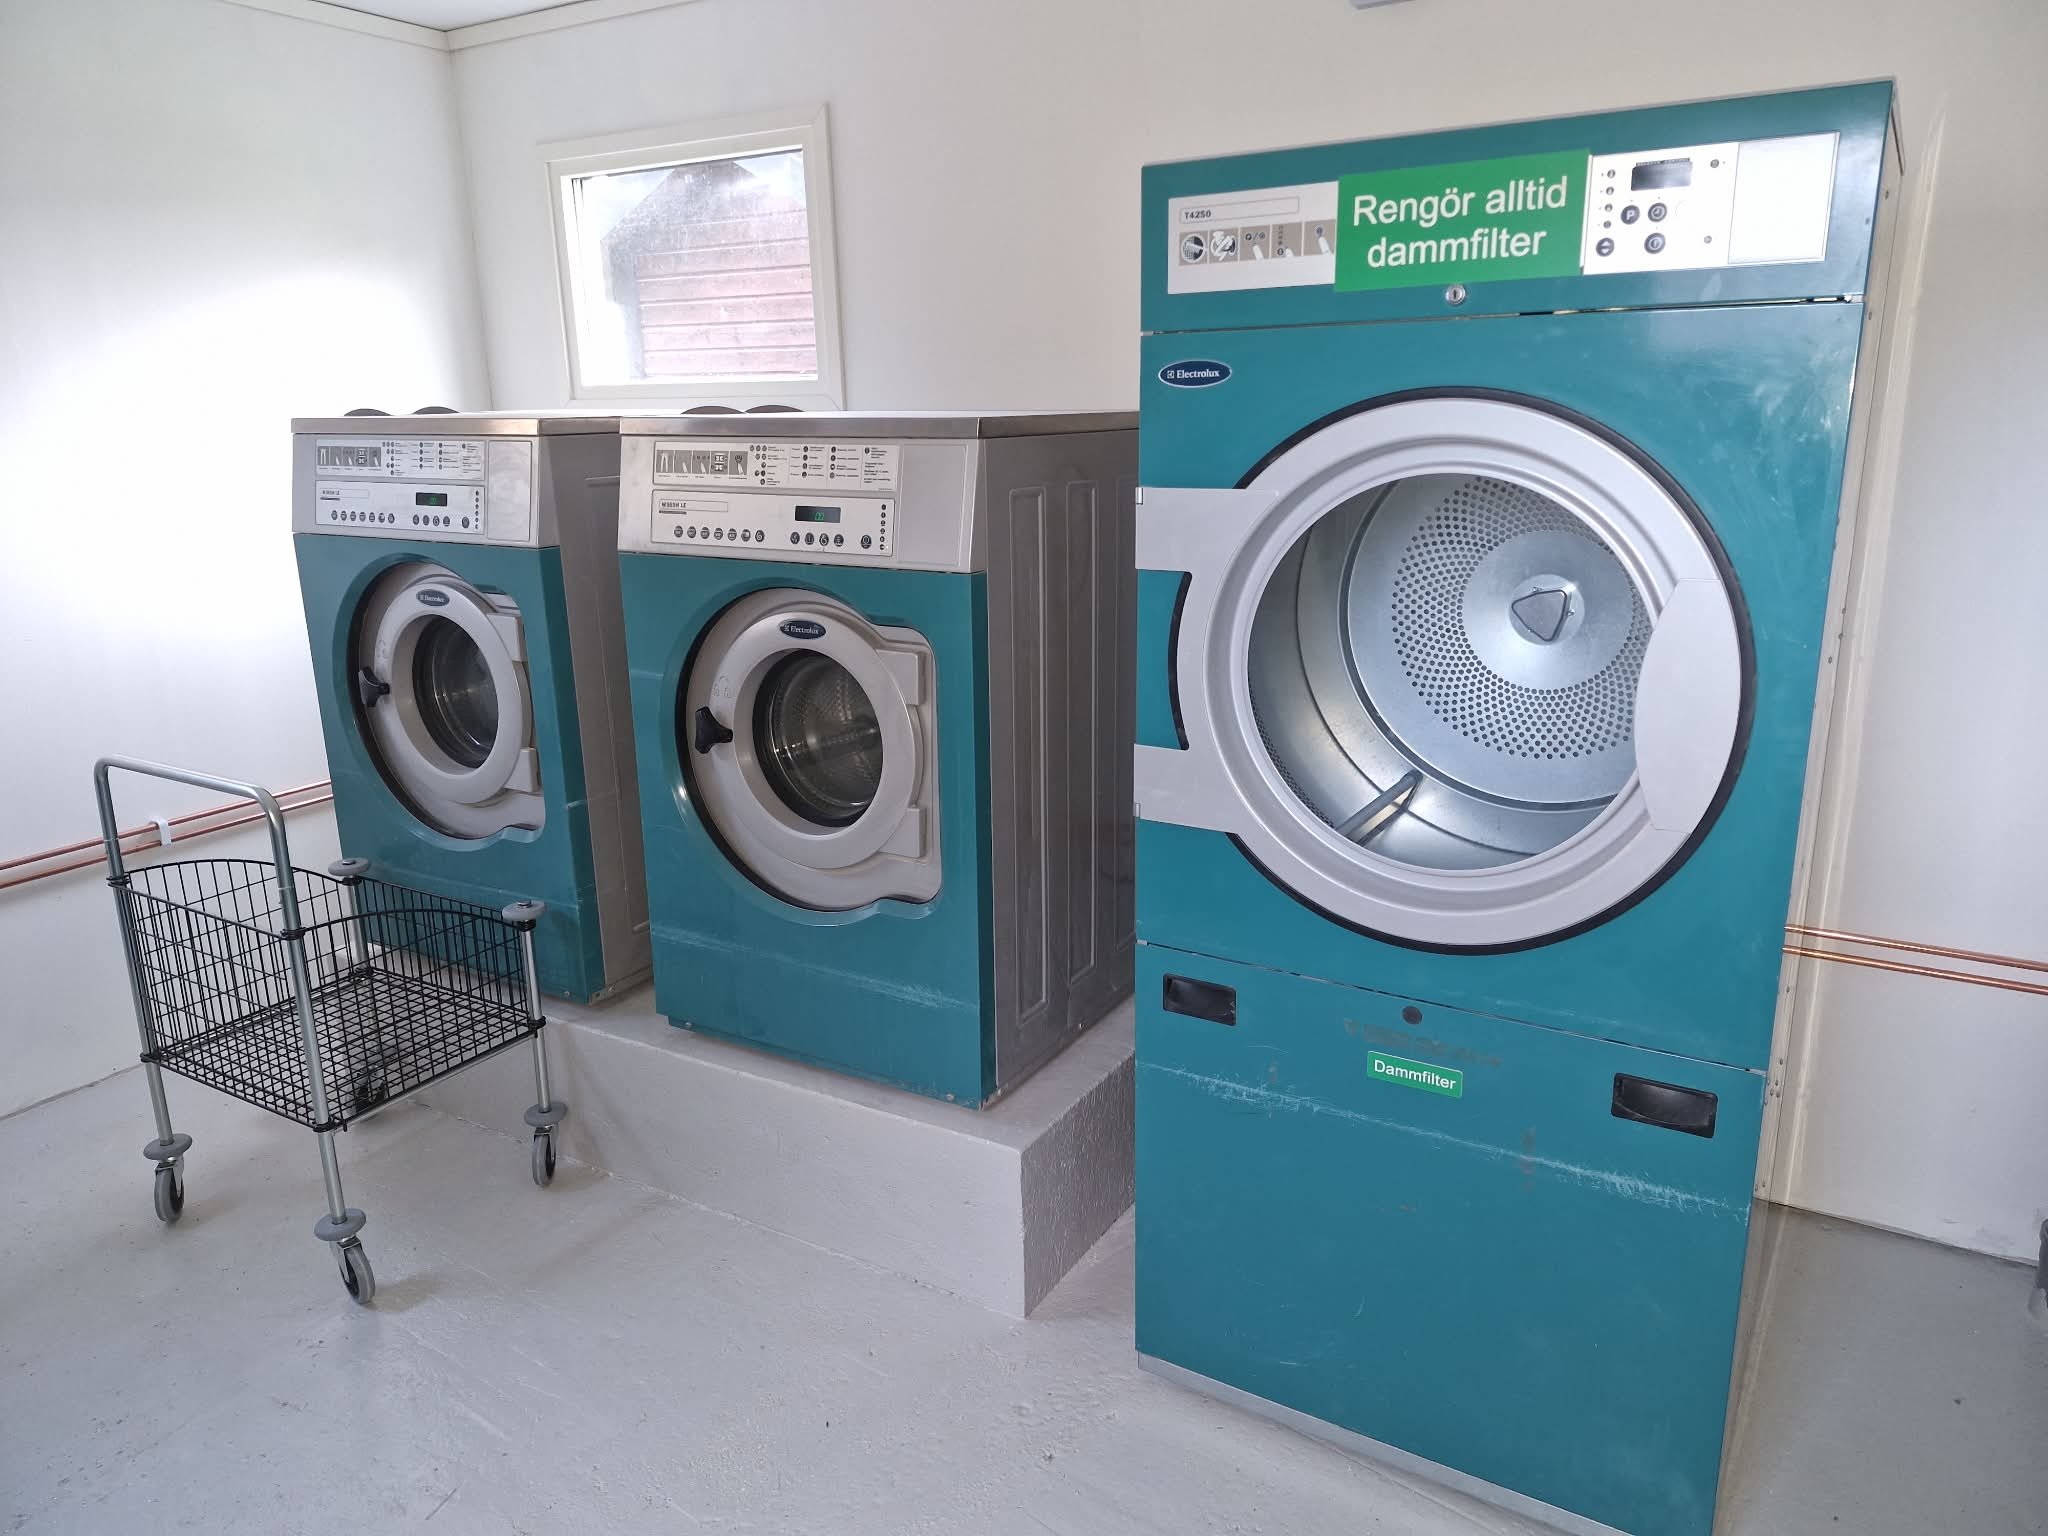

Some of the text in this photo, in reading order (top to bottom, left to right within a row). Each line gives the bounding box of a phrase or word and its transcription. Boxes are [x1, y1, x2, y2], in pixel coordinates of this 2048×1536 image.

[1353, 175, 1568, 228] Rengör alltid
[1183, 210, 1212, 220] T4250
[1366, 226, 1547, 268] dammfilter
[1176, 368, 1220, 379] Electrolux
[790, 625, 819, 635] Electrolux
[1374, 1059, 1457, 1090] Dammfilter
